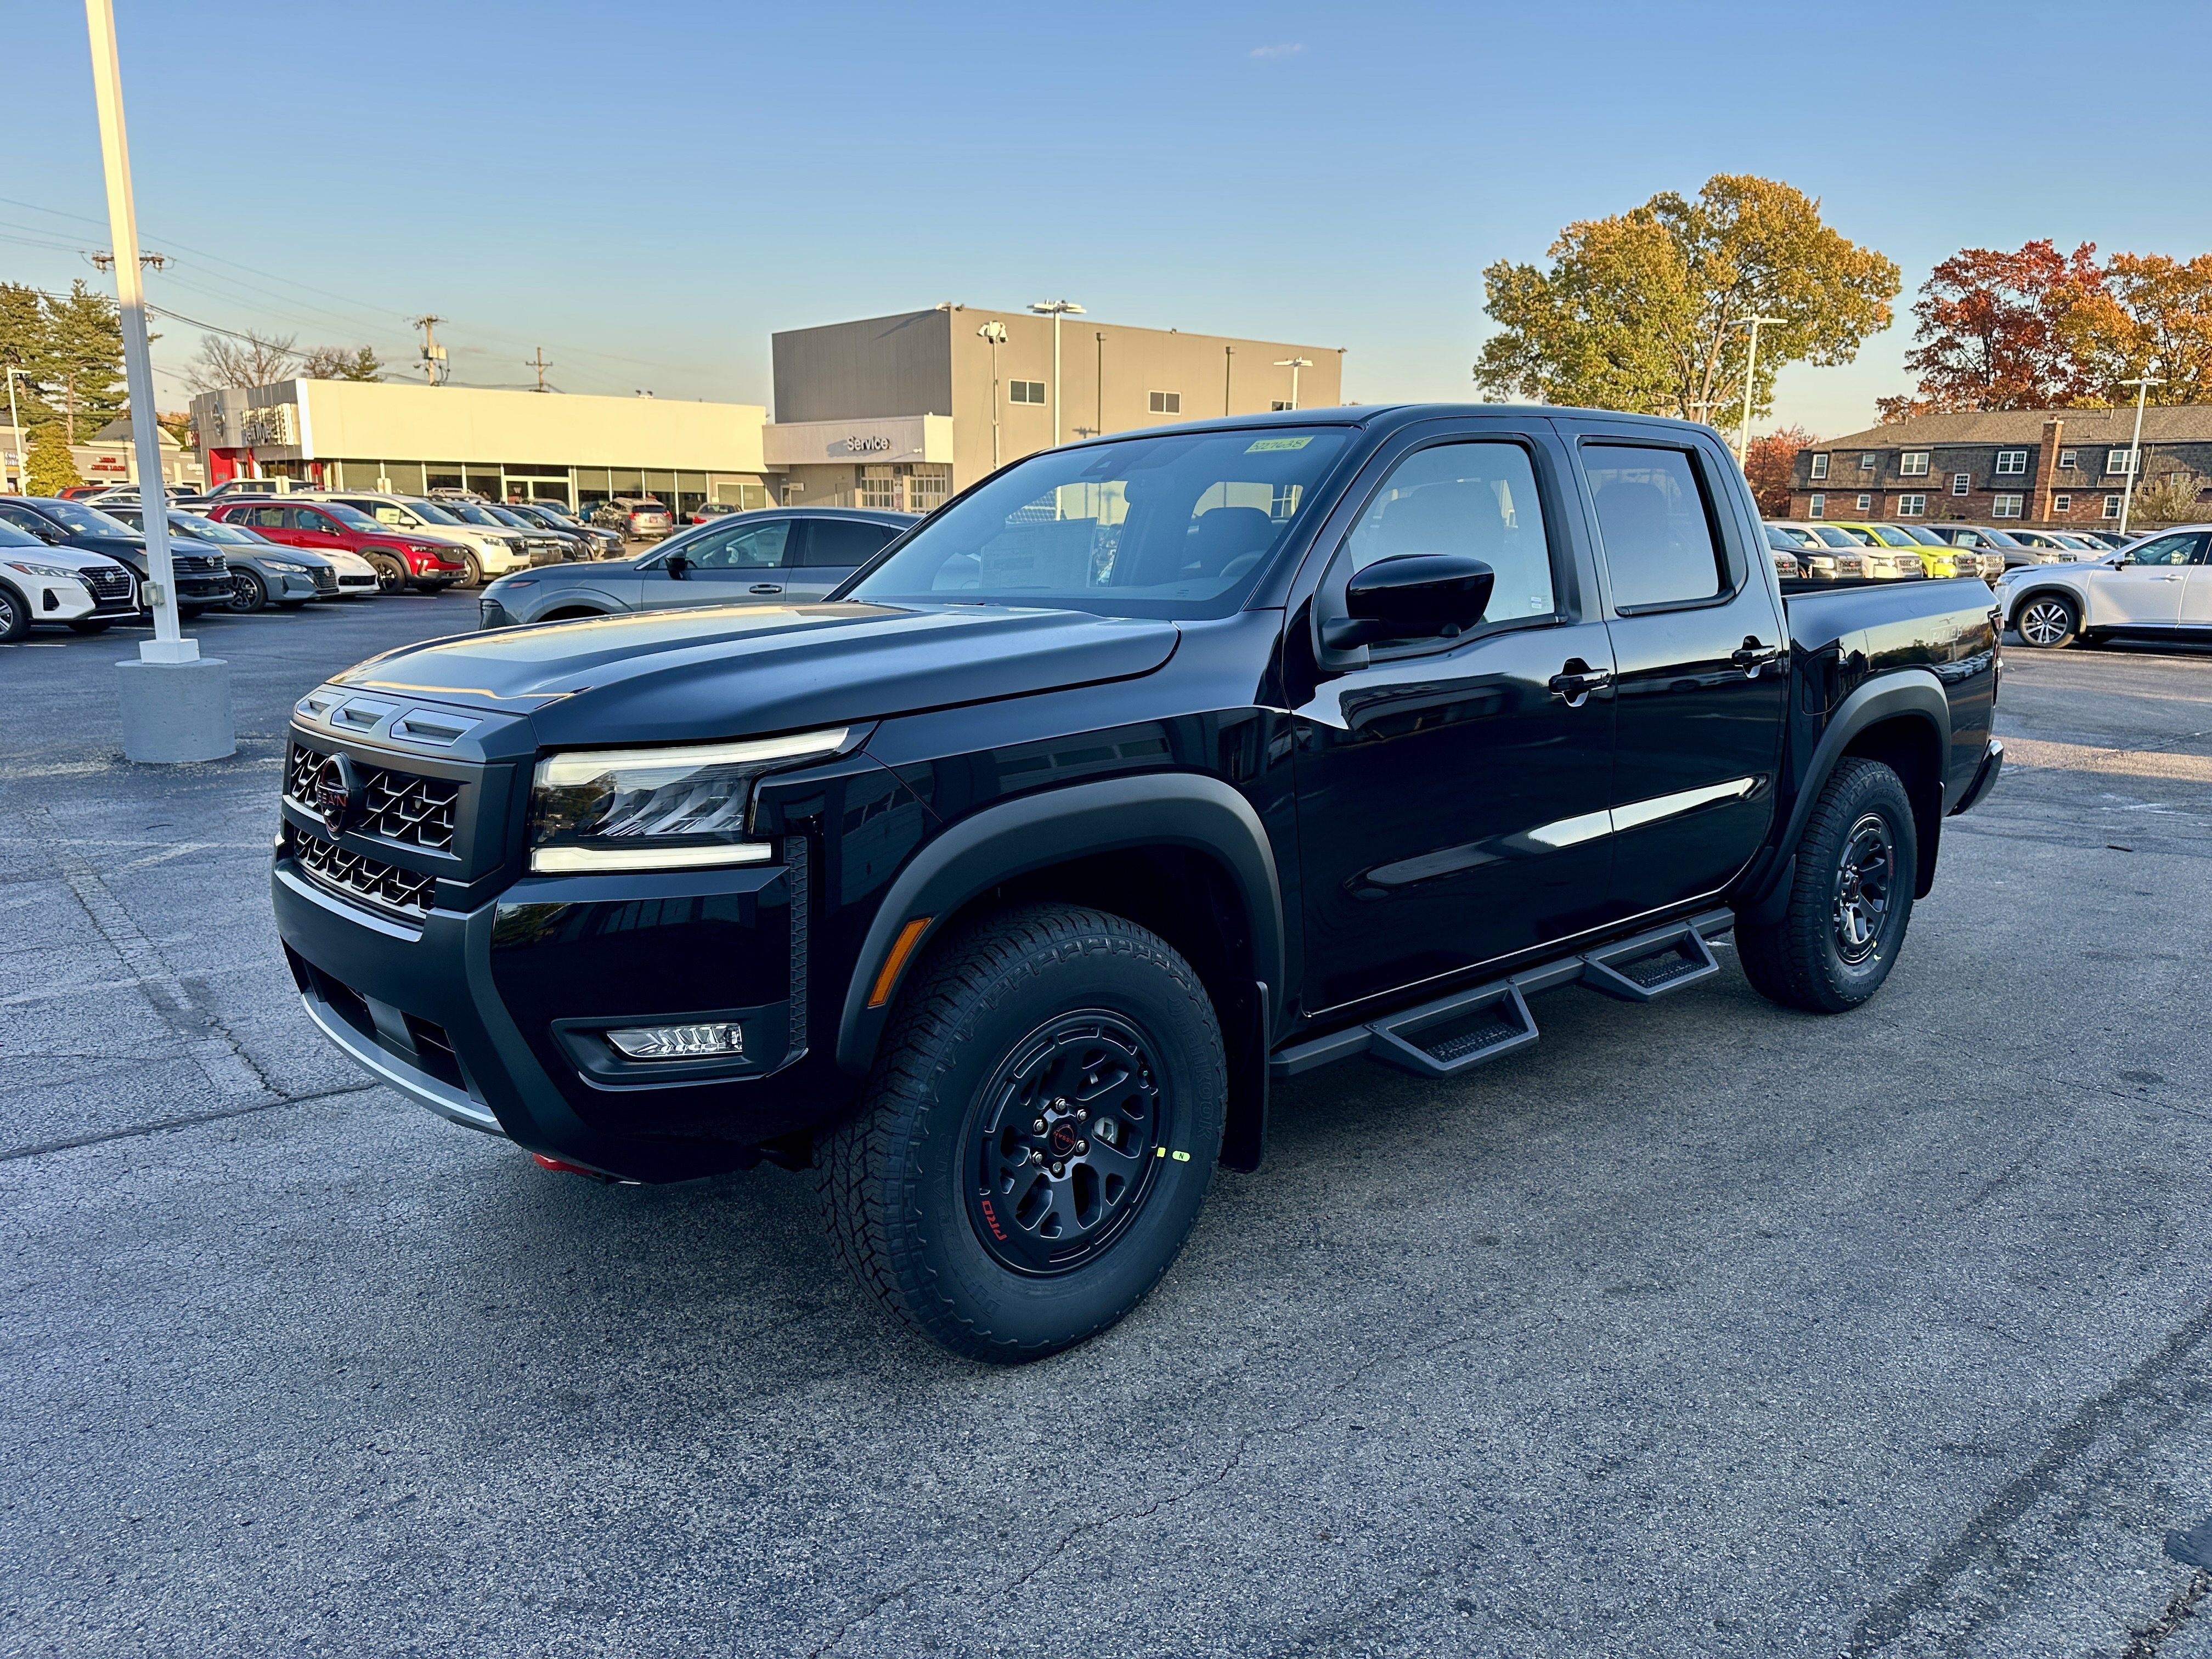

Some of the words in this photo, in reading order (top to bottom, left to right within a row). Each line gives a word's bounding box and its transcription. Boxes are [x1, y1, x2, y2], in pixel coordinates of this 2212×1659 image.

[847, 436, 888, 451] Service
[1176, 1012, 1214, 1141] Hankook
[1053, 1130, 1075, 1146] NISSAN
[981, 1200, 1008, 1240] PRO
